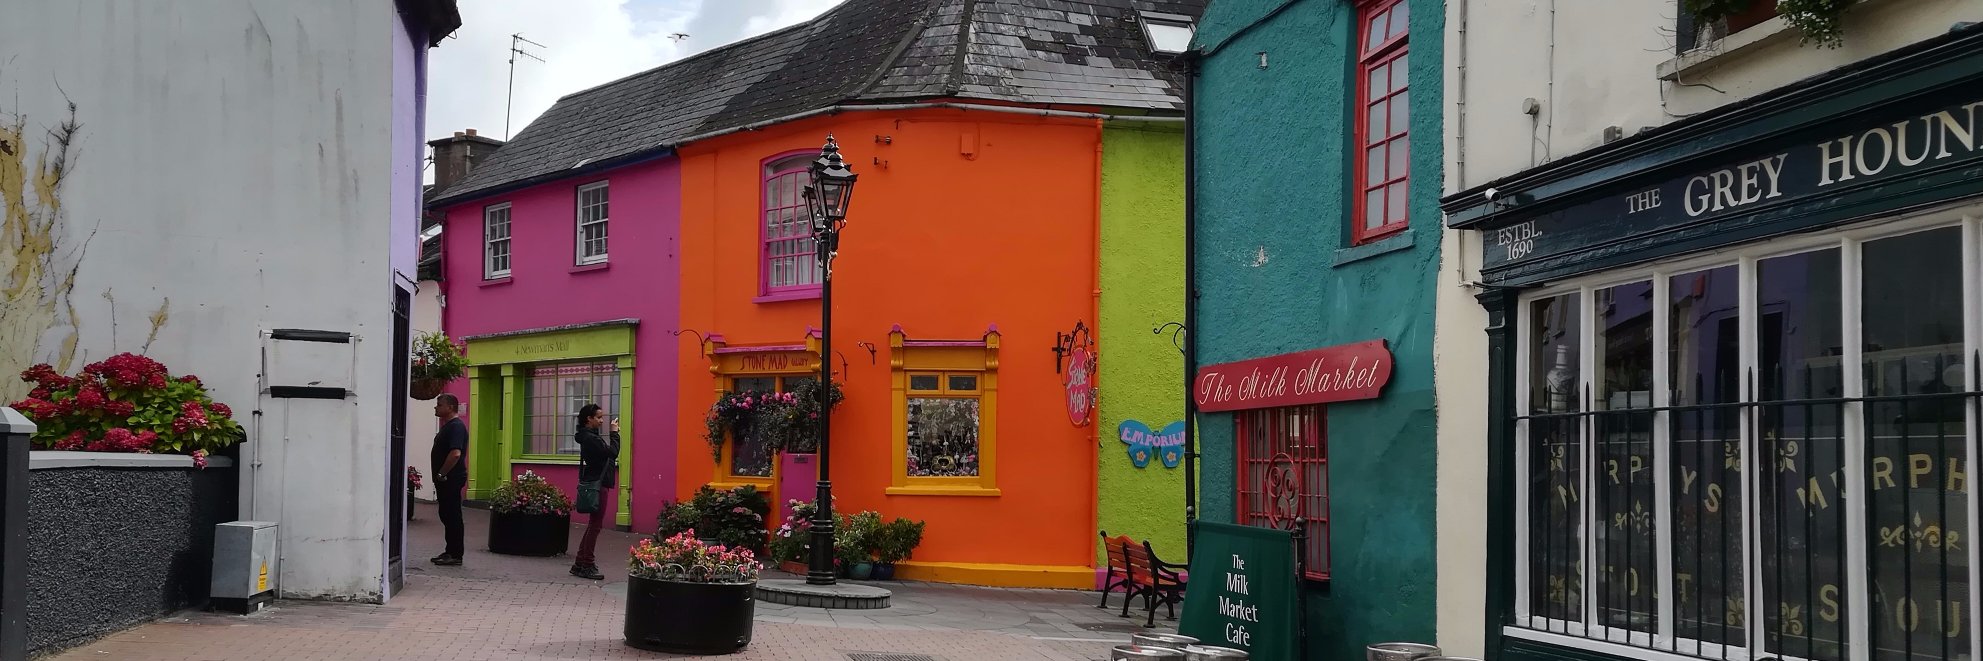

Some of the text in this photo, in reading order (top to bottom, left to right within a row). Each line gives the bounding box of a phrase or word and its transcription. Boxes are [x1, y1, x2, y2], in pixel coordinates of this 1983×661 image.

[1625, 101, 1983, 217] THE GREY HOUN
[1498, 219, 1543, 247] ESTBL.
[1506, 239, 1534, 261] 1690
[740, 354, 767, 371] STONE
[768, 353, 788, 370] MAD
[1199, 356, 1380, 405] The Milk Market
[1070, 389, 1086, 413] MAD
[1557, 455, 1723, 513] MRPYS
[1232, 554, 1245, 570] The
[1226, 572, 1249, 595] Milk
[1218, 595, 1259, 623] Market
[1226, 622, 1251, 647] Cafe
